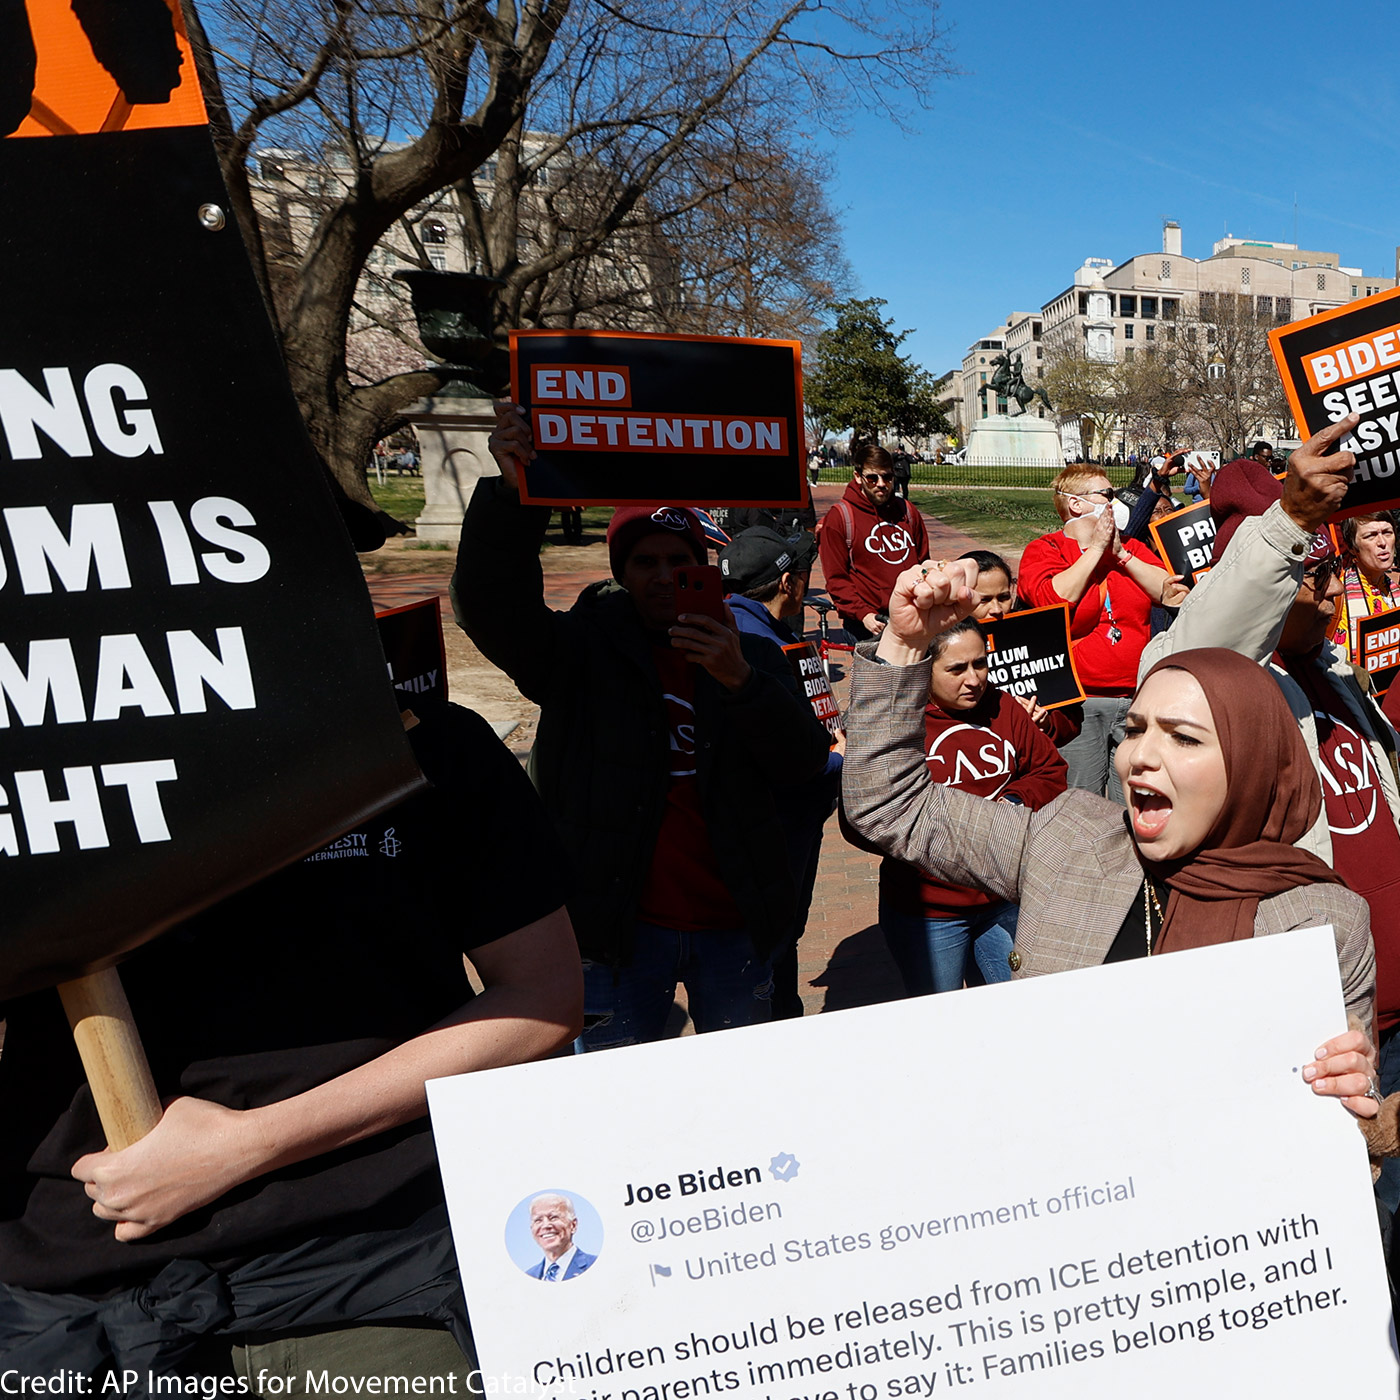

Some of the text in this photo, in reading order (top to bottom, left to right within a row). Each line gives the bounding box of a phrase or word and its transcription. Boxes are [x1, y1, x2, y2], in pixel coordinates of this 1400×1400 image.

[536, 369, 627, 401] END
[538, 413, 781, 451] DETENTION
[147, 496, 271, 586] IS
[864, 530, 916, 554] CASA
[1367, 627, 1400, 650] END
[1011, 653, 1065, 680] FAMILY
[1367, 648, 1400, 673] DET
[624, 1166, 762, 1207] Joe Biden
[630, 1202, 783, 1244] @JoeBiden
[685, 1176, 1136, 1281] United States government official
[533, 1212, 1320, 1386] Children should be released from ICE detention with
[621, 1246, 1334, 1400] parents immediately. This is pretty simple, and I
[887, 1371, 937, 1398] say
[944, 1362, 975, 1387] it:
[981, 1339, 1105, 1380] Families
[1112, 1313, 1215, 1354] belong
[1219, 1286, 1348, 1330] together.
